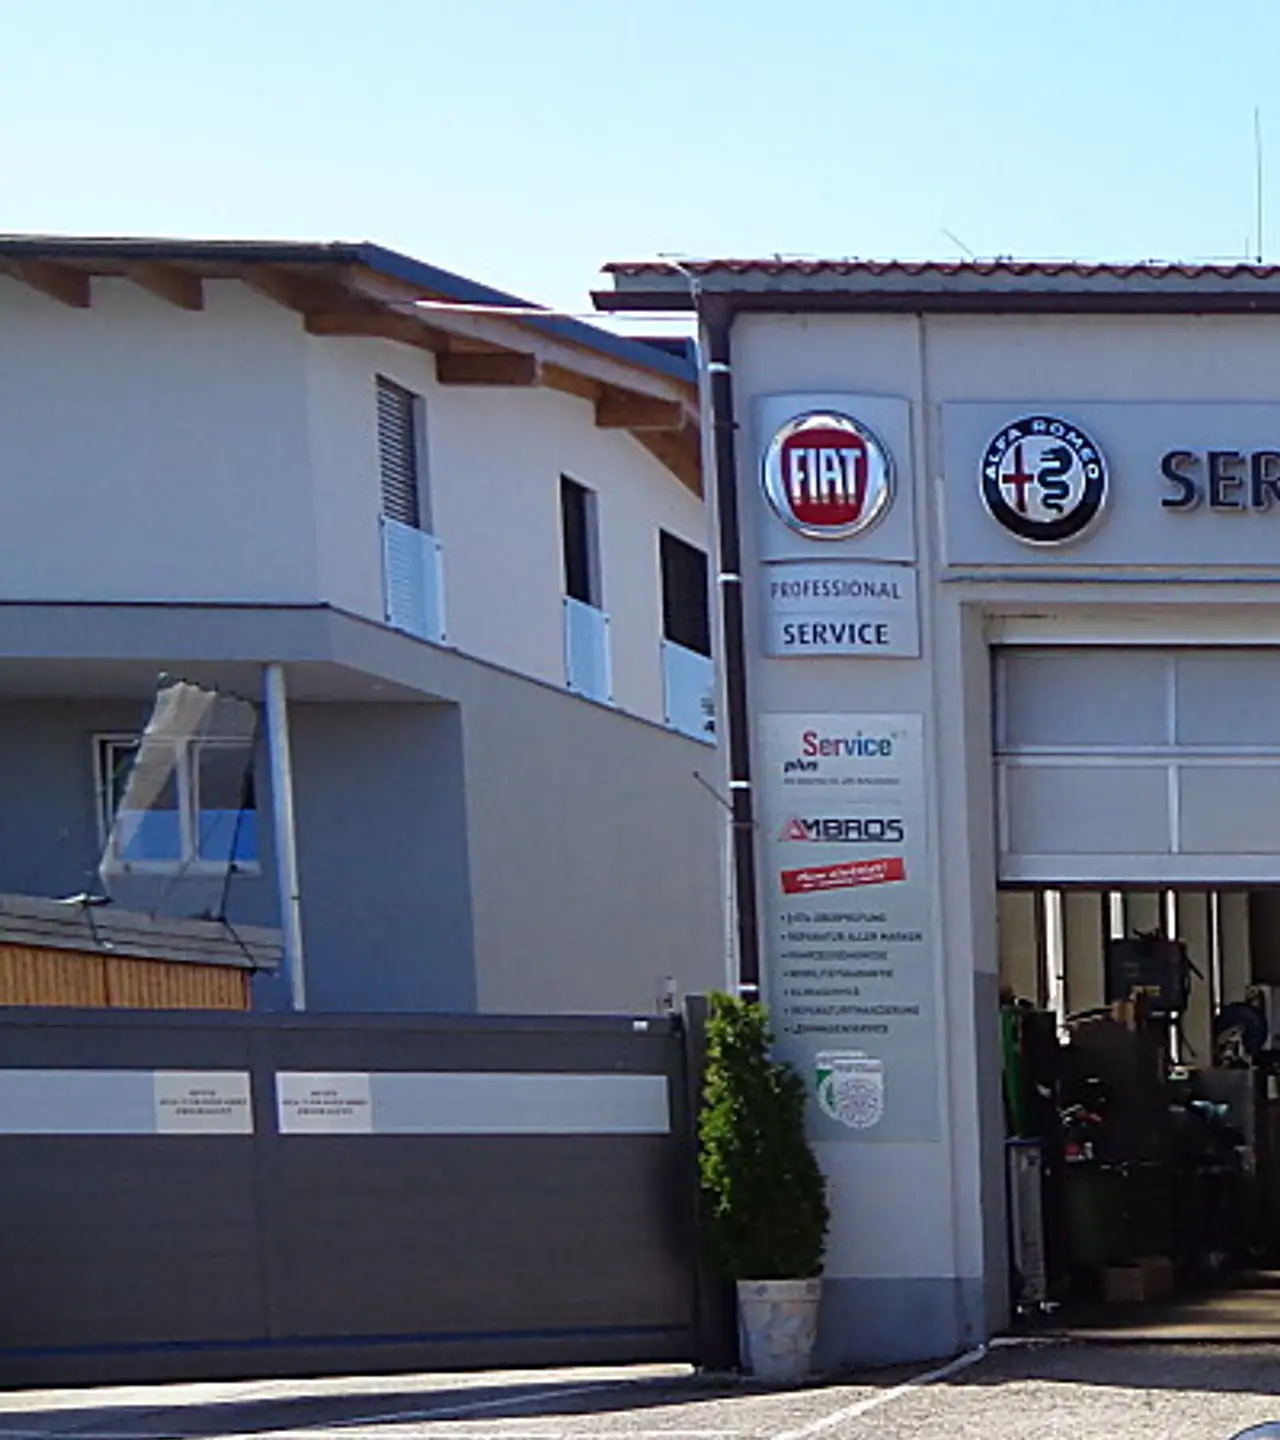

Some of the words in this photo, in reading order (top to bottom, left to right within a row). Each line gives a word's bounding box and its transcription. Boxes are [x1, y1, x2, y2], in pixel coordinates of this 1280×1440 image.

[986, 428, 1022, 480] ALFA
[1031, 420, 1099, 478] ROMEO
[789, 448, 862, 505] FIAT
[770, 578, 902, 600] PROFESSIONAL
[783, 623, 889, 646] SERVICE
[803, 730, 891, 757] Service
[779, 817, 904, 843] AMBROS
